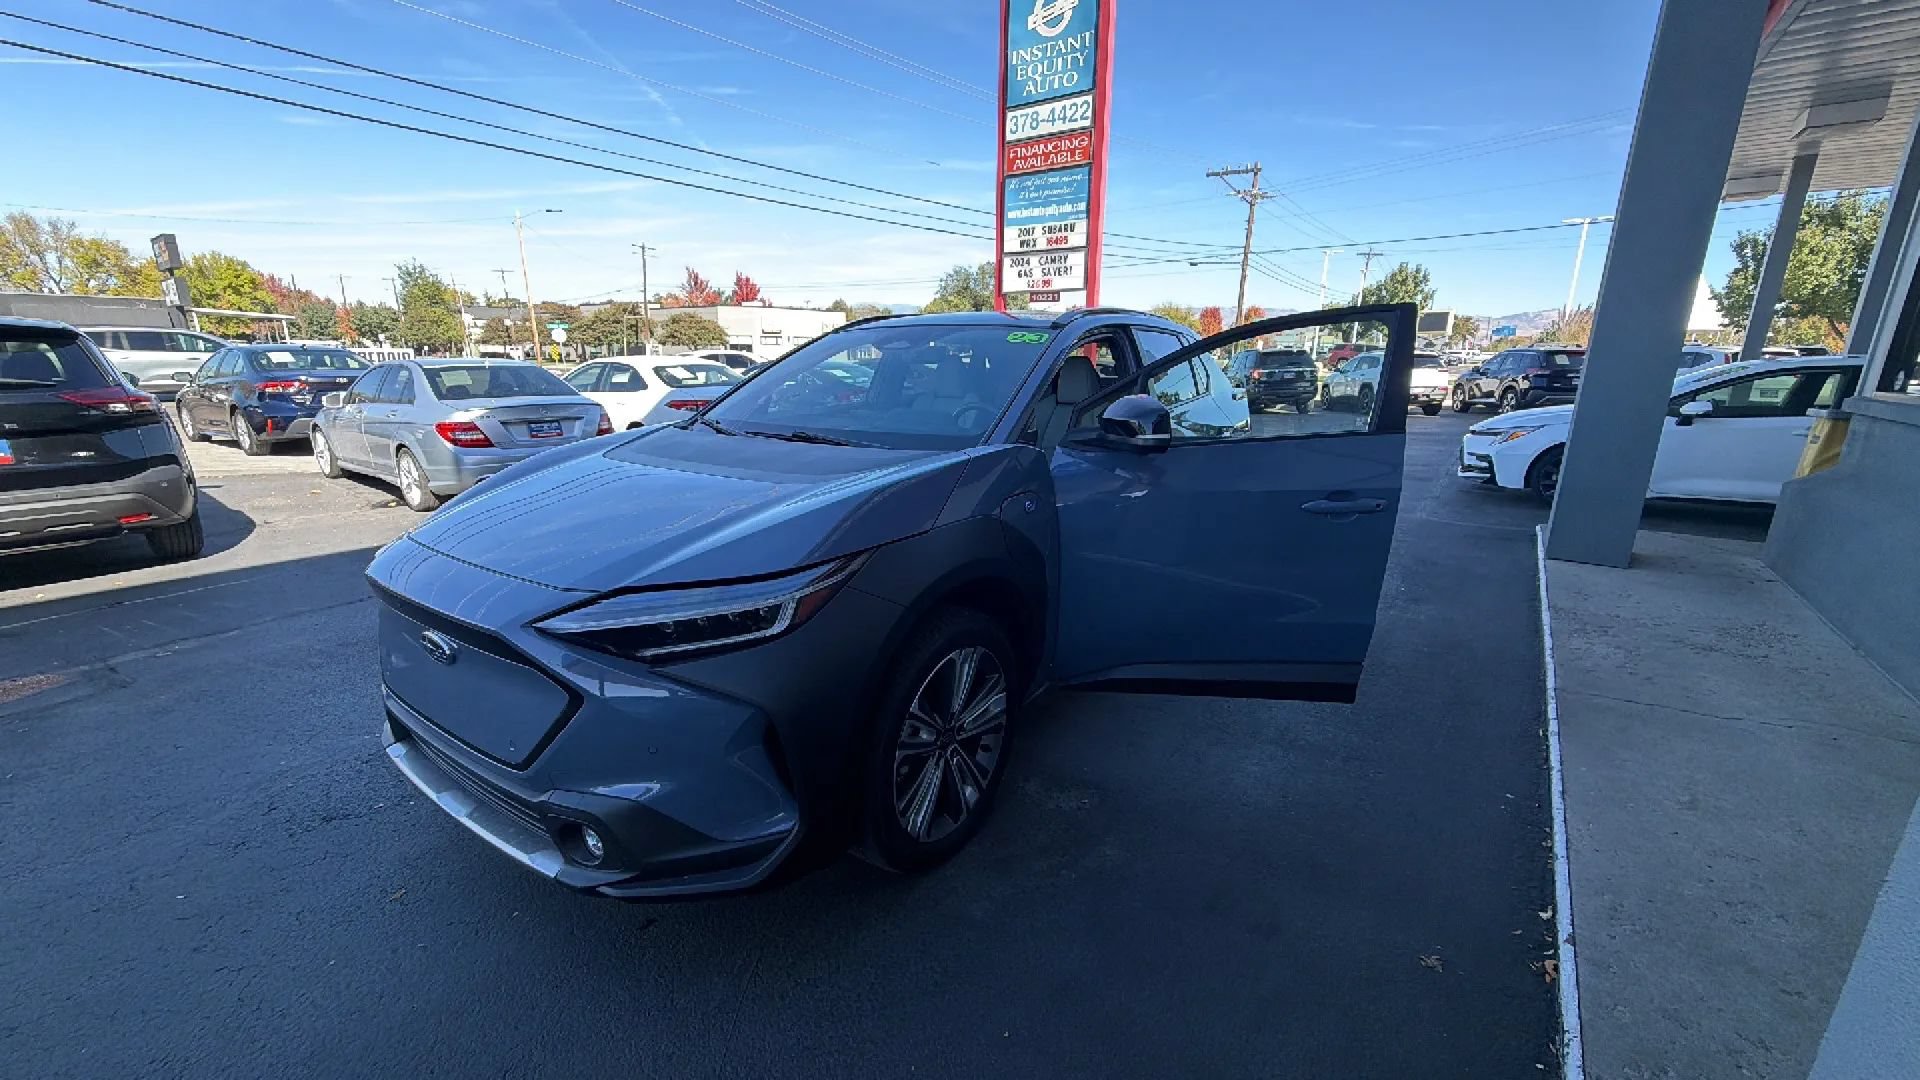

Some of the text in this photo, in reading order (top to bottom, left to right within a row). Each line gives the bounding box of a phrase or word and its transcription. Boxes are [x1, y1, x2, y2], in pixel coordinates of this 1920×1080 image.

[1012, 30, 1094, 64] INSTANT
[1017, 50, 1088, 80] EQUITY
[1023, 72, 1078, 96] AUTO
[1009, 100, 1090, 134] 378-4422
[1010, 136, 1088, 159] FINANCING
[1013, 150, 1084, 170] AVAILABLE
[1018, 222, 1076, 238] 2017 SUBARU
[1019, 238, 1037, 248] WRX
[1010, 255, 1069, 268] 2024 CAMRY
[1017, 269, 1034, 278] GAS
